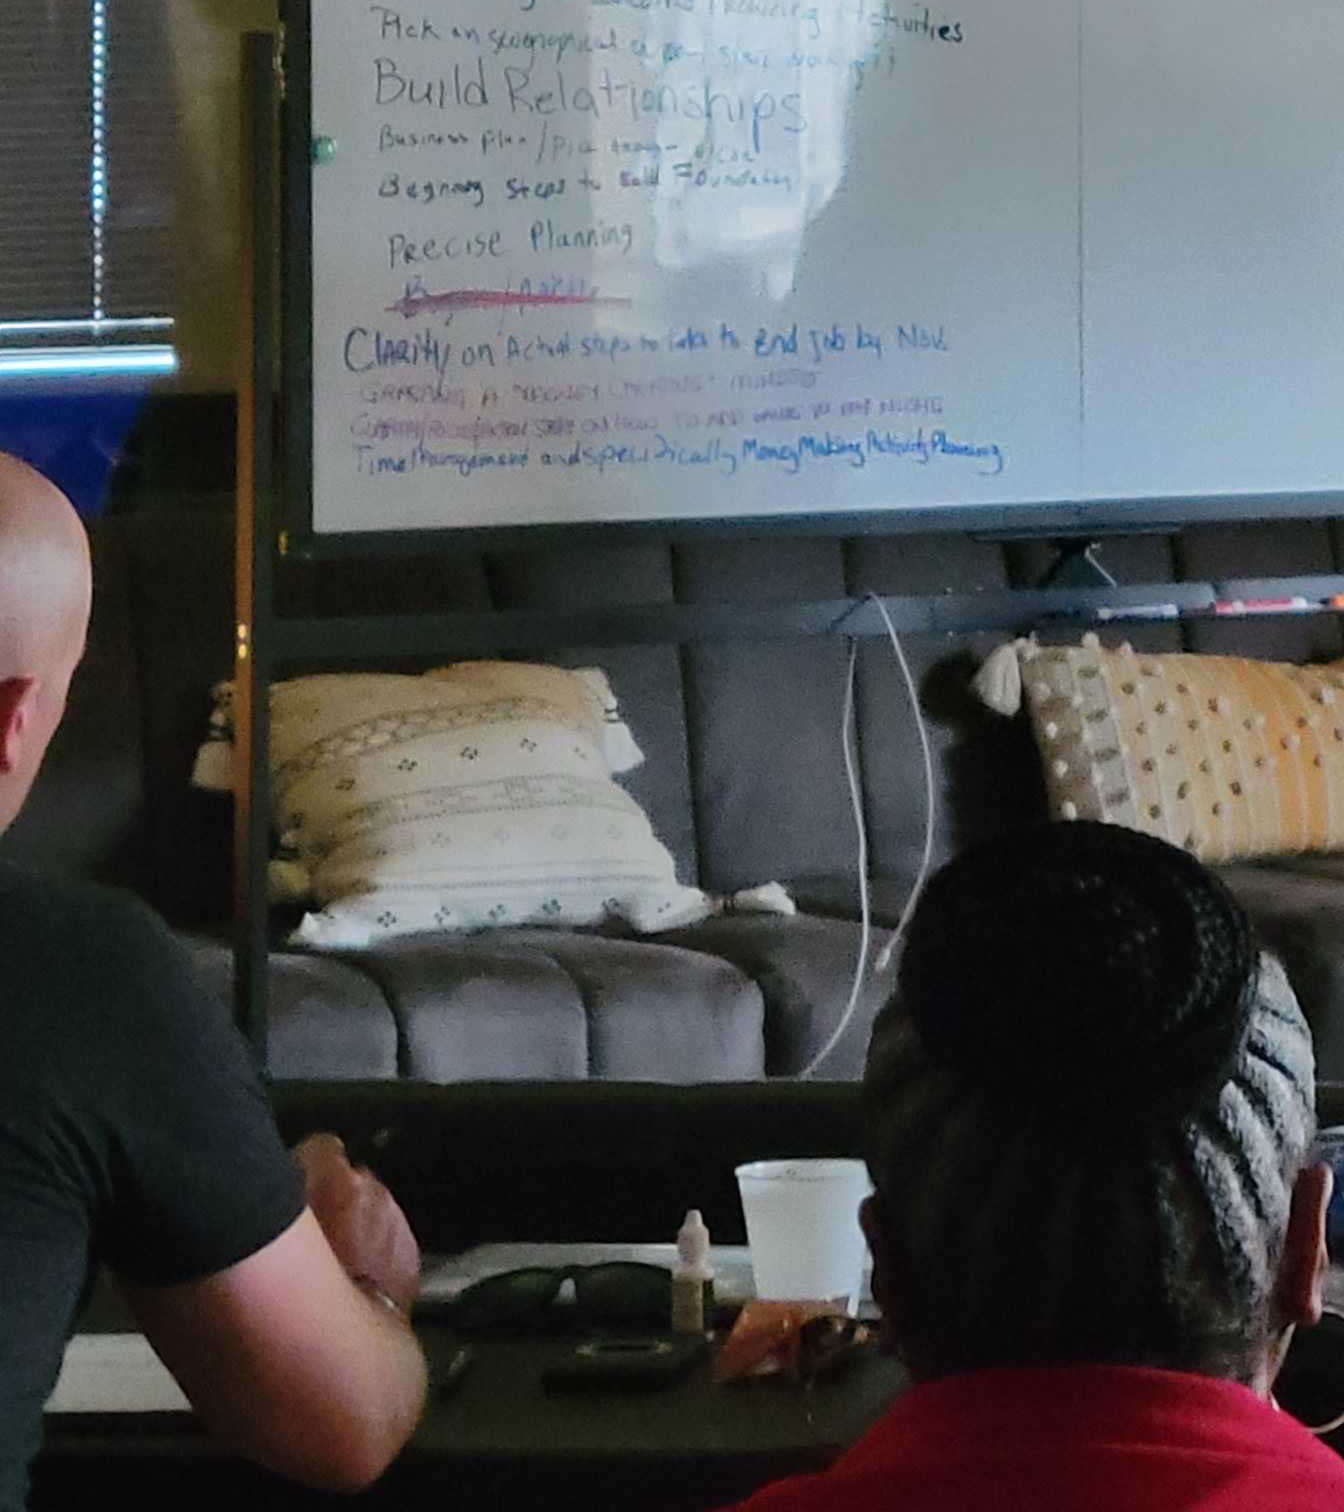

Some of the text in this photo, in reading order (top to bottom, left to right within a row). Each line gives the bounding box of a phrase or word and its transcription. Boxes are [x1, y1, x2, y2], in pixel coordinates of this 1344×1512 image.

[374, 56, 488, 109] Build
[505, 65, 808, 154] Relationships
[530, 218, 633, 253] Planning
